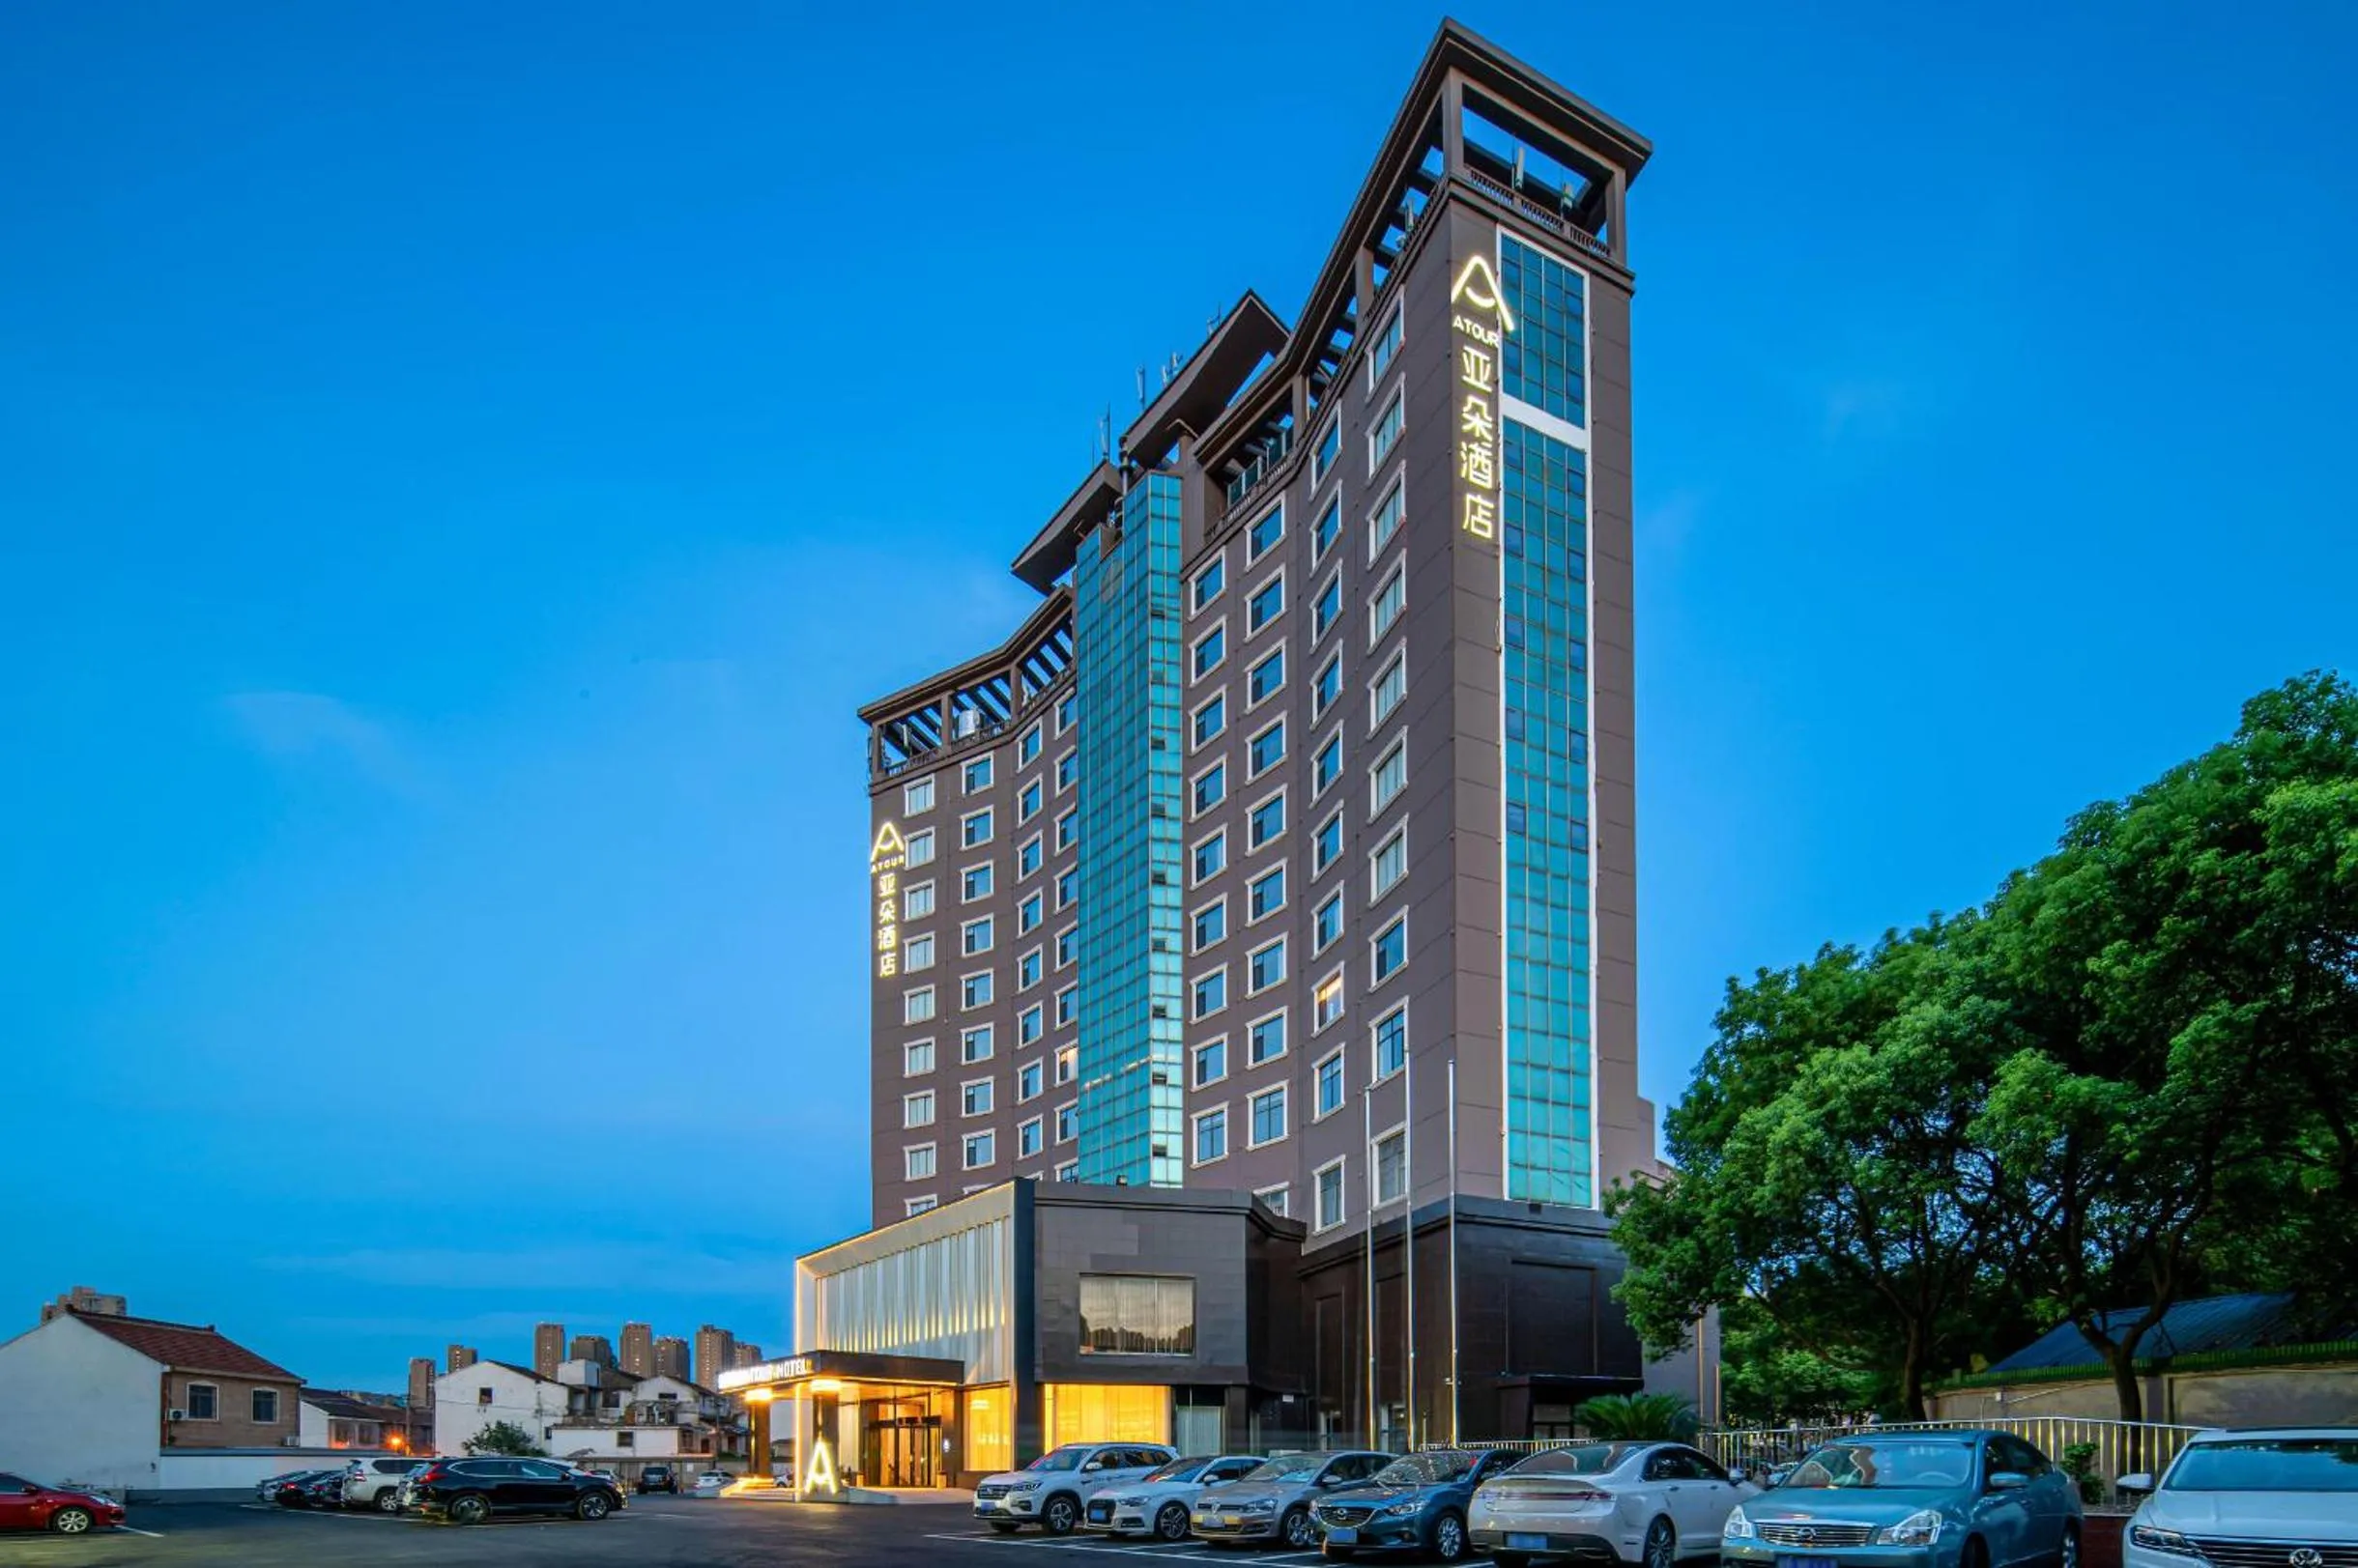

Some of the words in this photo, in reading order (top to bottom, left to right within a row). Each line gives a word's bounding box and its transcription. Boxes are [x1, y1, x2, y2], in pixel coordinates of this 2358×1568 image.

[1452, 314, 1499, 348] ATOUR
[1461, 345, 1494, 539] 亚朵酒店
[871, 854, 905, 873] ATOUR
[877, 872, 897, 978] 亚朵酒店
